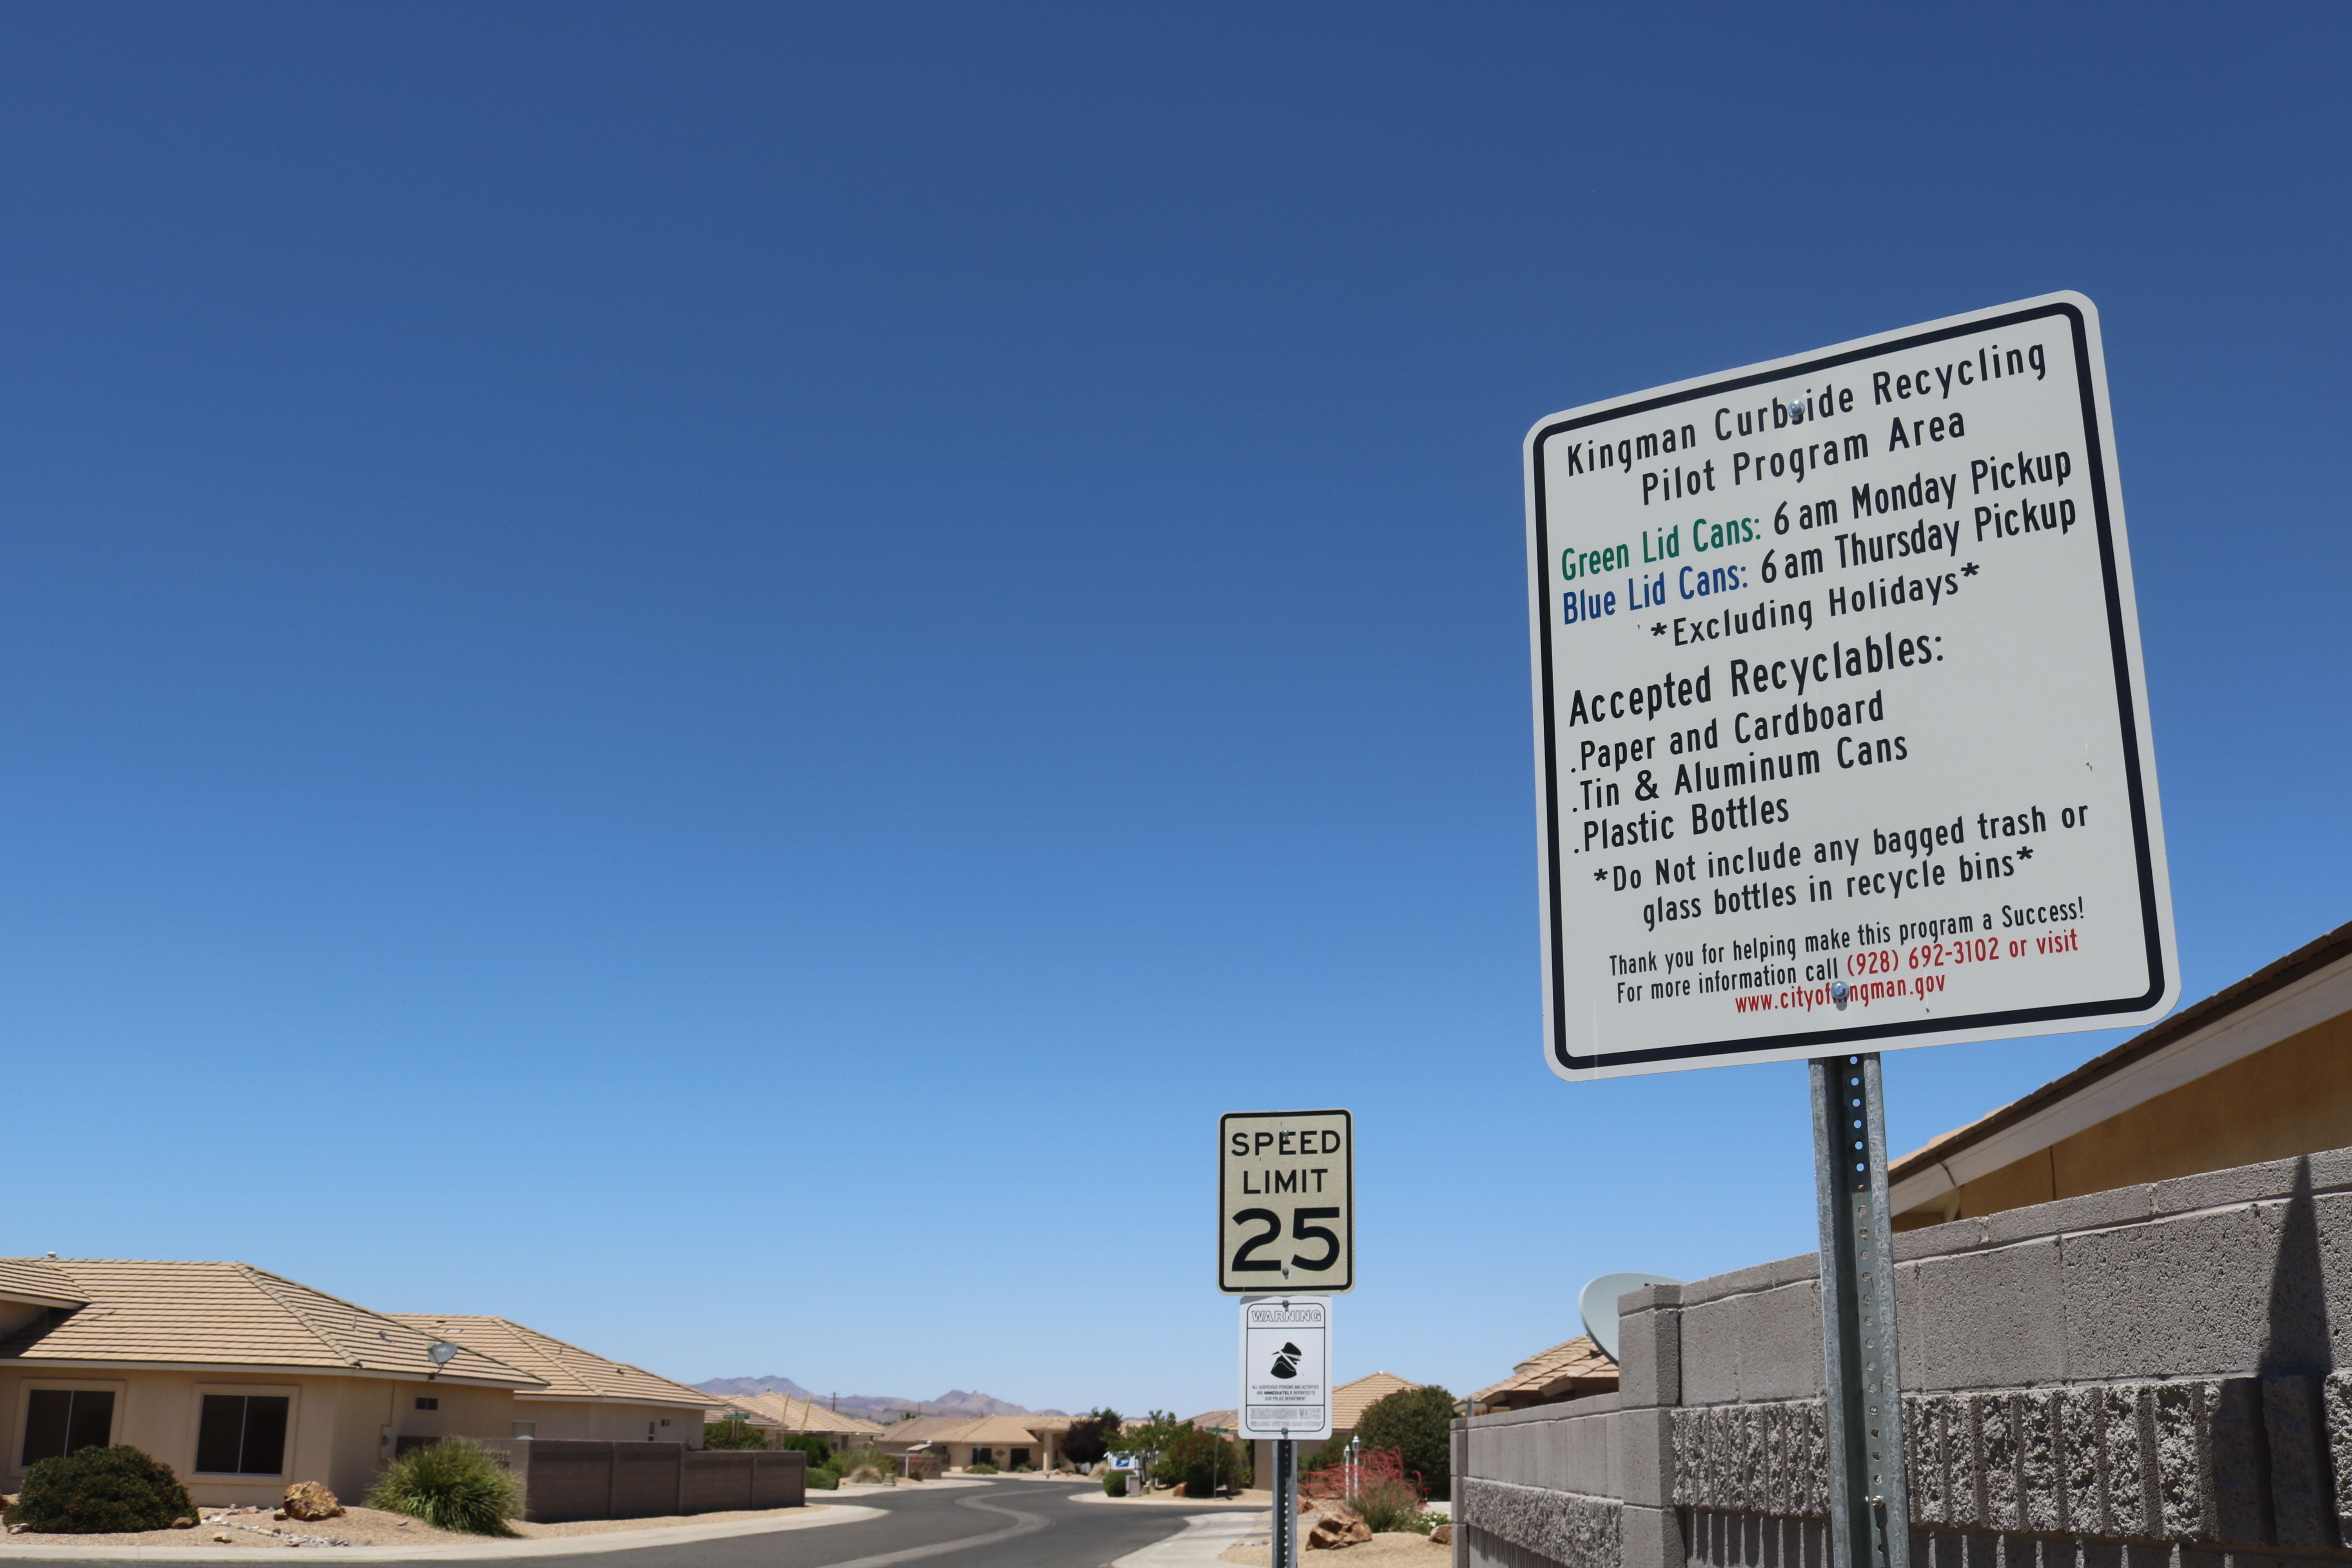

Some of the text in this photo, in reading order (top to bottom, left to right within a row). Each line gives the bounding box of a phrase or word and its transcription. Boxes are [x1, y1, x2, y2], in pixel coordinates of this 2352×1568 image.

[1568, 424, 1696, 477] Kingman
[1873, 344, 2045, 405] Recycling
[1642, 412, 1965, 506] Pilot Program Area
[1562, 544, 1629, 581] Green
[1642, 524, 1679, 563] Lid
[1693, 517, 1761, 552] Cans:
[1851, 472, 1956, 519] Monday
[1971, 451, 2071, 495] Pickup
[1563, 589, 1616, 625] Blue
[1628, 571, 1666, 611] Lid
[1679, 565, 1748, 600] Cans:
[1834, 518, 1960, 568] Thursday
[1974, 498, 2076, 542] Pickup
[1569, 631, 1943, 727] Accepted Recyclables:
[1670, 717, 1718, 755] and
[1735, 689, 1884, 744] Cardboard
[1635, 769, 1660, 801] &
[1674, 750, 1820, 795] Aluminum
[1837, 736, 1907, 769] Cans
[1655, 855, 1696, 886] Not
[1708, 841, 1801, 878] include
[1814, 838, 1859, 866] any
[1873, 815, 1964, 859] bagged
[1977, 805, 2046, 840] trash
[2062, 805, 2088, 829] or
[1691, 795, 1789, 835] Bottles
[1643, 896, 1701, 932] glass
[1714, 882, 1797, 915] bottles
[1809, 875, 1832, 902] in
[1847, 860, 1945, 899] recycle
[1609, 896, 2084, 976] Thank you for helping make this program a Success!
[1617, 928, 2078, 1004] For more information call (928) 692-3102 or visit
[1231, 1130, 1341, 1156] SPEED
[1243, 1168, 1328, 1194] LIMIT
[1231, 1207, 1340, 1272] 25
[1251, 1310, 1321, 1322] WARNING
[1250, 1408, 1321, 1420] NEIGHBORHOOD WATCH
